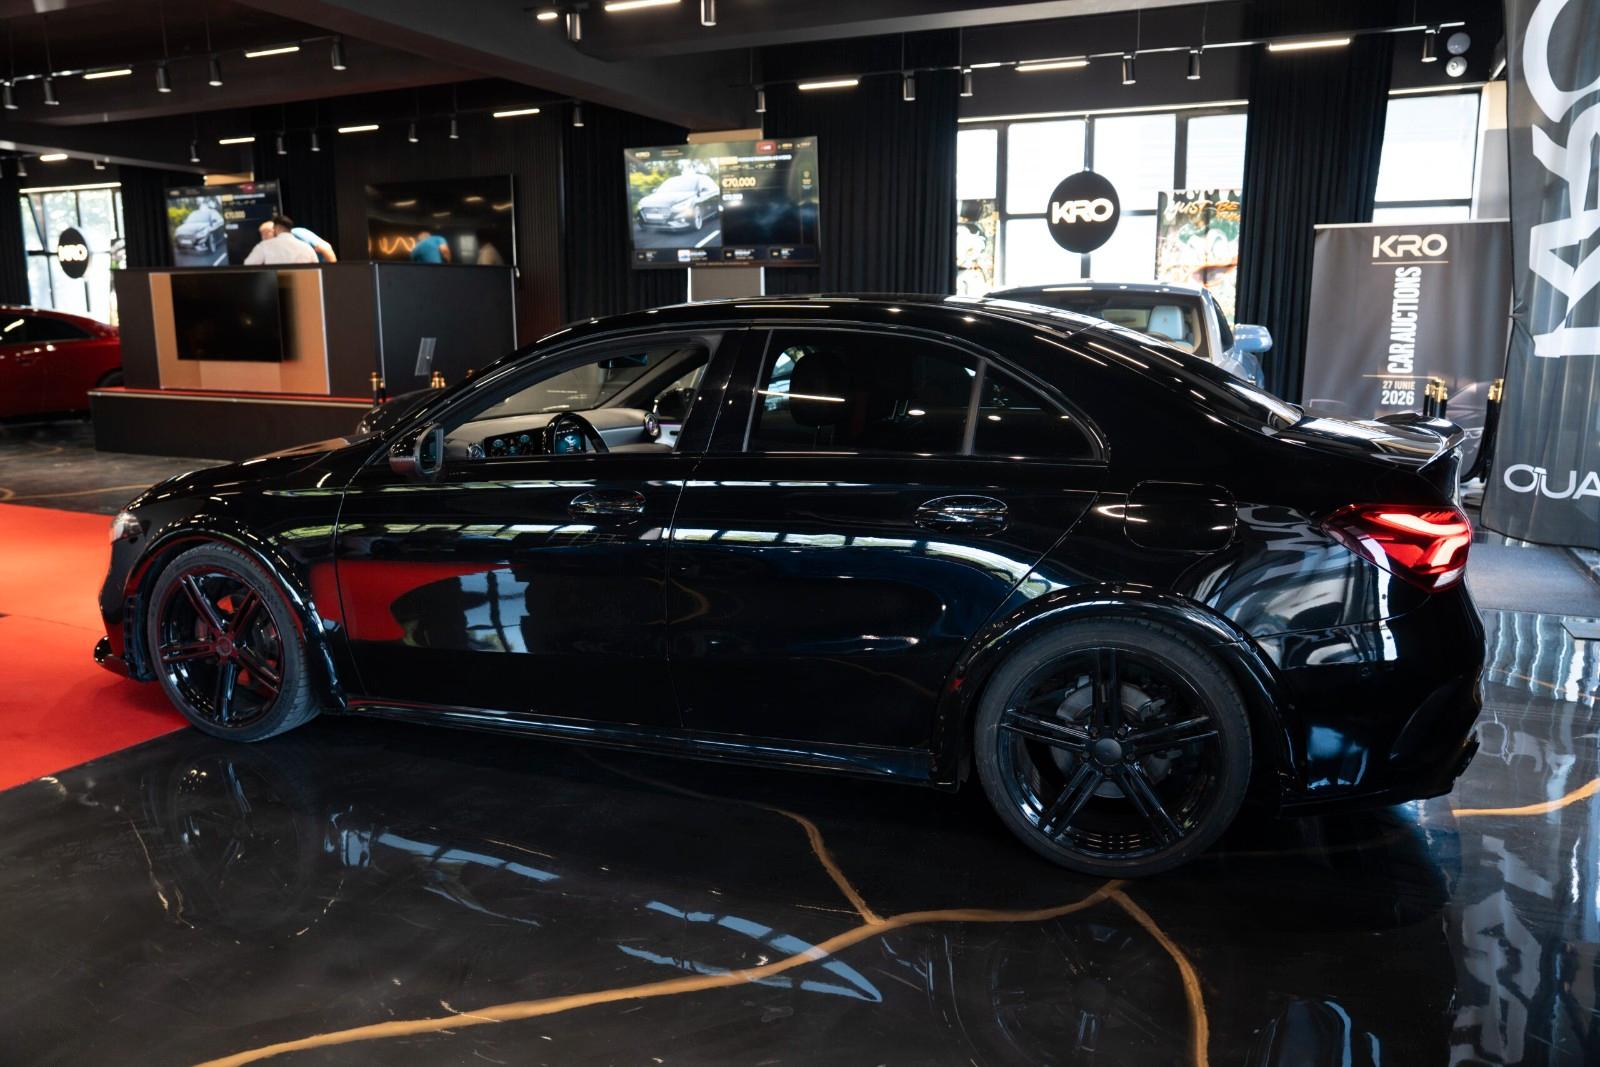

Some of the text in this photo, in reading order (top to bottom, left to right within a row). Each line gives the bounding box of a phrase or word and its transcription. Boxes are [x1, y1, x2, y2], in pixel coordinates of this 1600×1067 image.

[1051, 198, 1114, 225] KRO
[1372, 233, 1448, 258] KRO
[1382, 380, 1415, 391] 27 IUNIE
[1381, 390, 1415, 406] 2026
